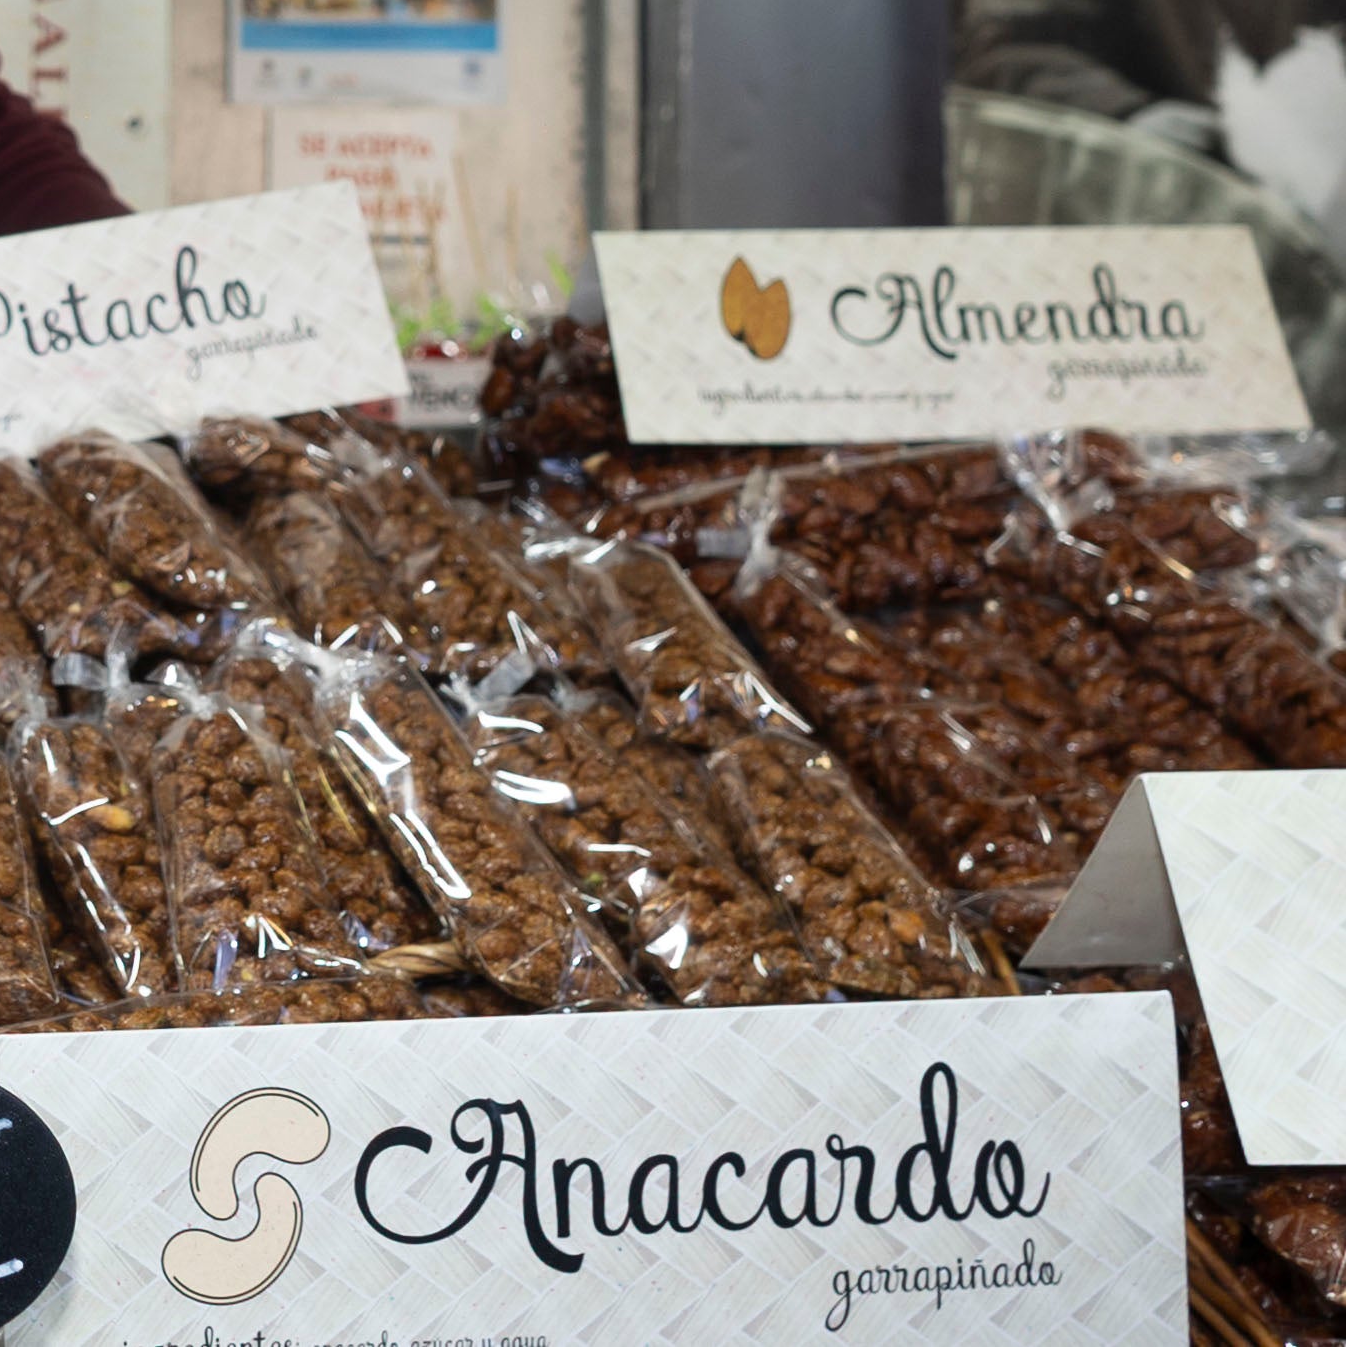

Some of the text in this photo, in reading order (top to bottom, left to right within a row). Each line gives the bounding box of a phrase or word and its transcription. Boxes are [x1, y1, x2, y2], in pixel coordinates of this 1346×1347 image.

[830, 262, 1206, 360] Almendra
[353, 1060, 1051, 1273] Anacardo
[824, 1237, 1064, 1333] garrapiñado
